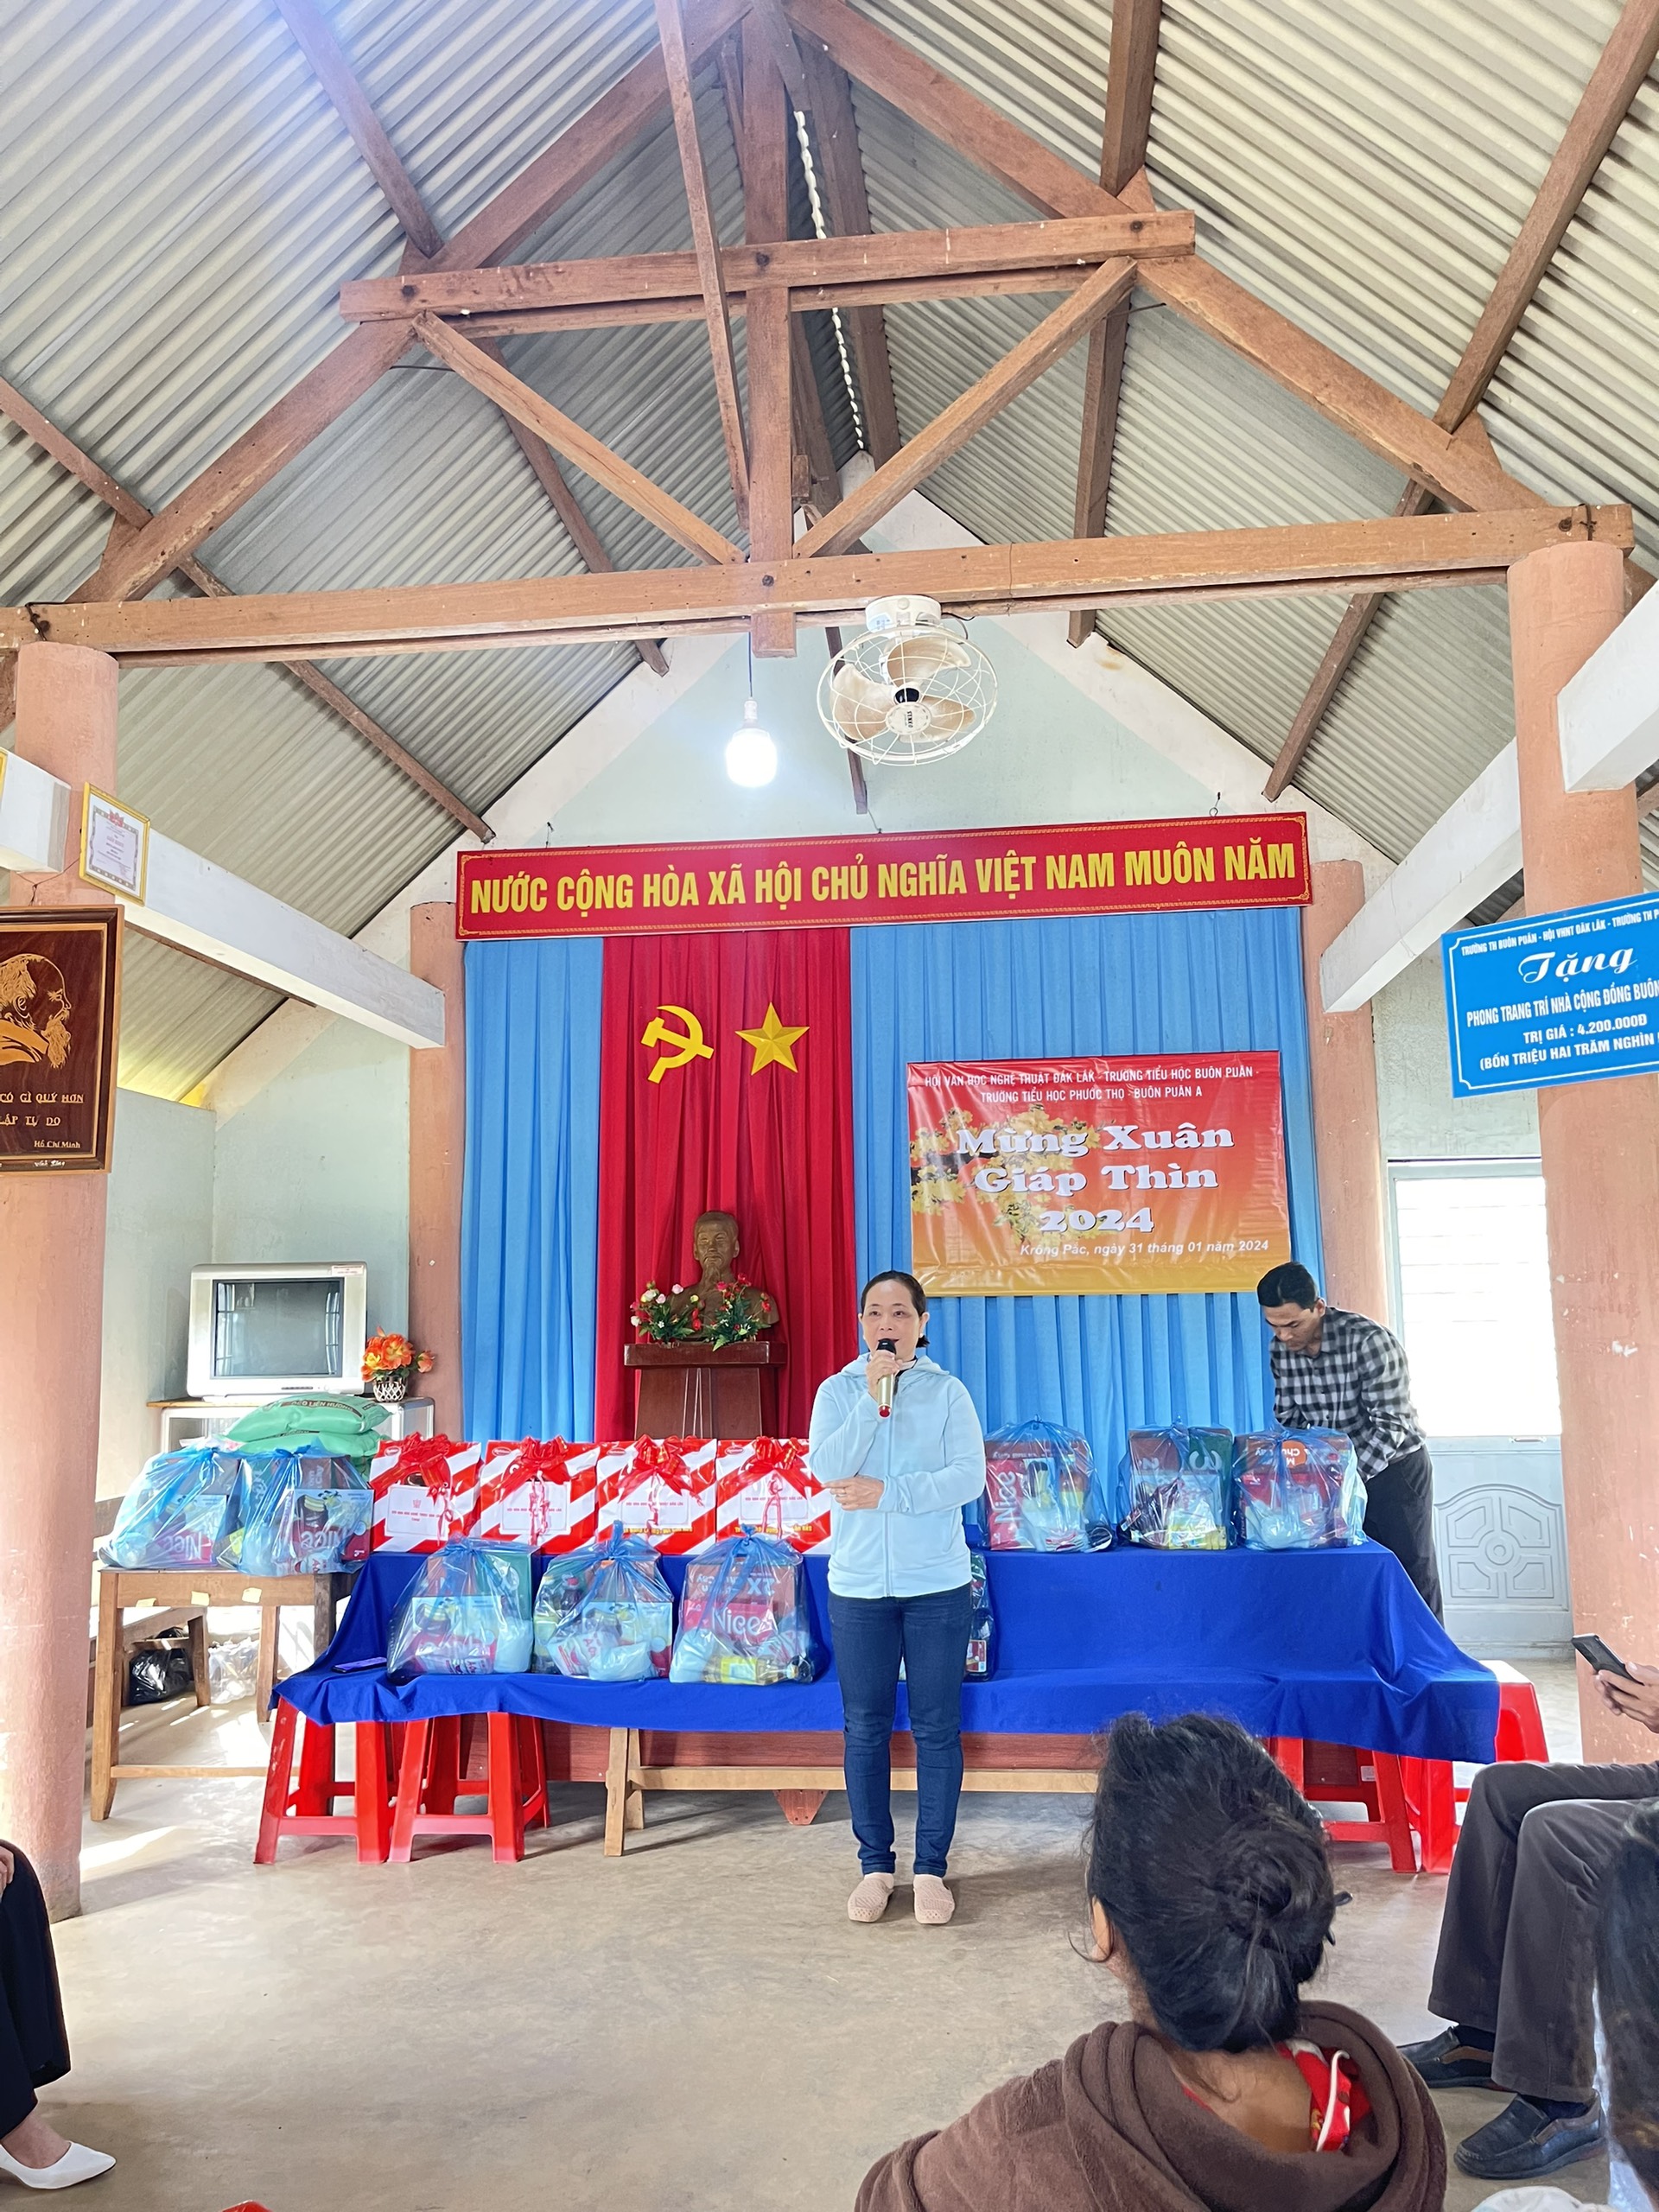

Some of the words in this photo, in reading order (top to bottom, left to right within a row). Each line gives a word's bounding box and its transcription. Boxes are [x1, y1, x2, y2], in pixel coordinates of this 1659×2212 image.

[470, 871, 548, 914] NƯỚC
[556, 868, 633, 918] CỘNG
[643, 865, 699, 908] HÒA
[708, 862, 746, 906] XÃ
[755, 861, 802, 910] HỘI
[811, 854, 868, 901] CHỦ
[878, 853, 967, 899] NGHĨA
[975, 850, 1036, 899] VIỆT
[1046, 852, 1115, 890] NAM
[1124, 841, 1216, 887] MUÔN
[1224, 836, 1296, 882] NĂM
[1488, 941, 1497, 951] TH
[1497, 937, 1517, 950] BUÔN
[1542, 928, 1555, 942] HỘI
[1611, 912, 1642, 927] TRƯỜNG
[1643, 910, 1653, 922] TH
[1518, 947, 1637, 983] Tặng
[1466, 1007, 1499, 1027] PHONG
[1500, 1001, 1532, 1022] TRANG
[1533, 995, 1549, 1017] TRÍ
[1550, 992, 1573, 1014] NHÀ
[1573, 988, 1602, 1013] CỘNG
[1633, 977, 1659, 1001] BUÔN
[1522, 1029, 1543, 1045] TRỊ
[1546, 1023, 1567, 1040] GIÁ
[1577, 1014, 1648, 1035] 4.200.000Đ
[1480, 1052, 1510, 1071] (BỐN
[1512, 1048, 1547, 1065] TRIỆU
[1550, 1045, 1572, 1060] HAI
[1573, 1039, 1610, 1056] TRĂM
[1612, 1032, 1655, 1051] NGHÌN
[990, 1073, 1015, 1088] NGHỆ
[1019, 1071, 1049, 1084] THUẬT
[1103, 1068, 1143, 1082] TRƯỜNG
[1147, 1065, 1167, 1081] TIỂU
[1195, 1065, 1222, 1079] BUÔN
[0, 1091, 14, 1103] CÓ
[19, 1091, 32, 1103] GÌ
[35, 1091, 58, 1104] QUÝ
[61, 1093, 84, 1103] HƠN
[981, 1089, 1019, 1103] TRƯỜNG
[1021, 1087, 1043, 1102] TIỂU
[1046, 1090, 1066, 1103] HỌC
[1069, 1086, 1103, 1101] PHƯỚC
[1106, 1088, 1125, 1102] THỌ
[1134, 1085, 1161, 1099] BUÔN
[1195, 1086, 1203, 1097] A
[46, 1116, 60, 1127] DO
[955, 1127, 1090, 1158] Mừng
[1103, 1122, 1235, 1151] Xuân
[974, 1166, 1088, 1197] Giáp
[1101, 1162, 1220, 1190] Thìn
[1039, 1206, 1154, 1233] 2024
[1020, 1244, 1059, 1257] Krông
[1094, 1243, 1125, 1256] ngày
[1128, 1243, 1142, 1253] 31
[1147, 1242, 1184, 1255] tháng
[1187, 1242, 1202, 1252] 01
[1206, 1241, 1234, 1252] năm
[1238, 1240, 1268, 1252] 2024
[995, 1470, 1025, 1526] Nice
[712, 1606, 760, 1636] Nice
